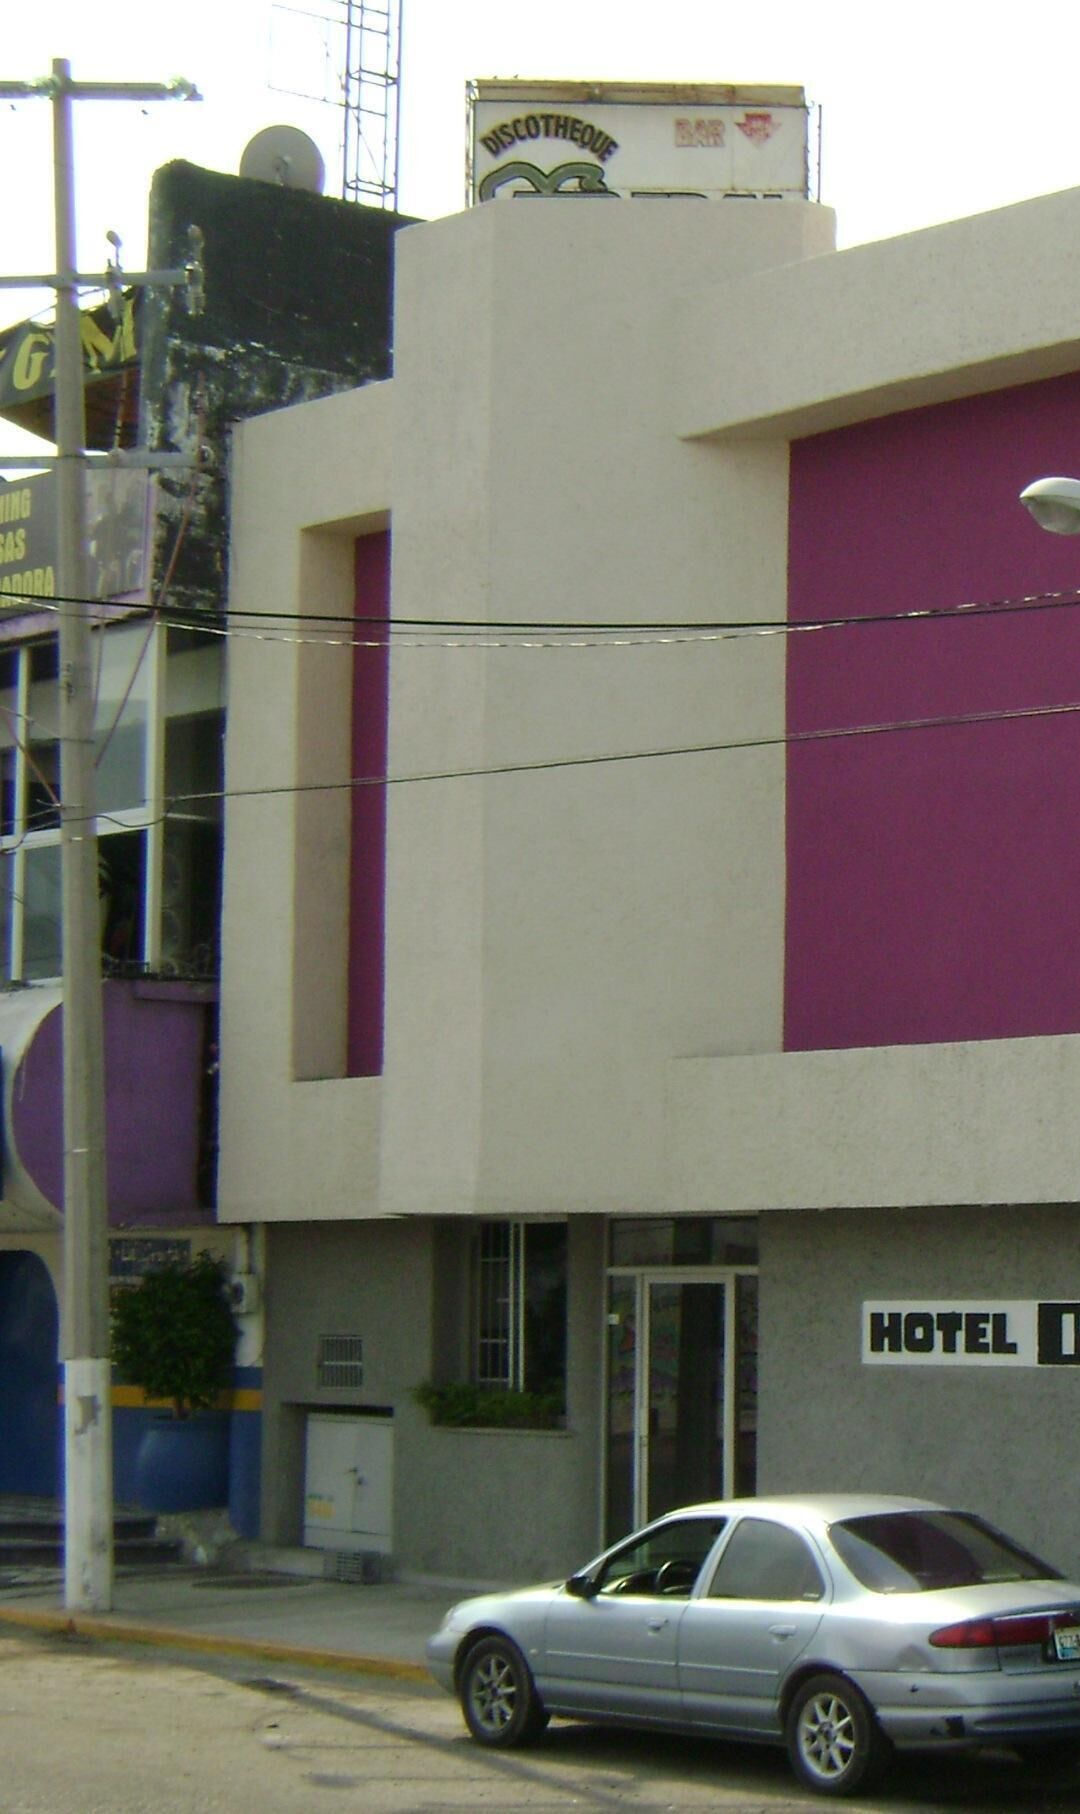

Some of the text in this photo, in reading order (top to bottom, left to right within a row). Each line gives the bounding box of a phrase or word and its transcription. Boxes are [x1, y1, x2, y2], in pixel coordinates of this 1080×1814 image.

[479, 113, 619, 163] DISCOTHEQUE
[675, 118, 726, 148] BAR
[13, 299, 137, 390] GM
[869, 1312, 1018, 1354] HOTEL
